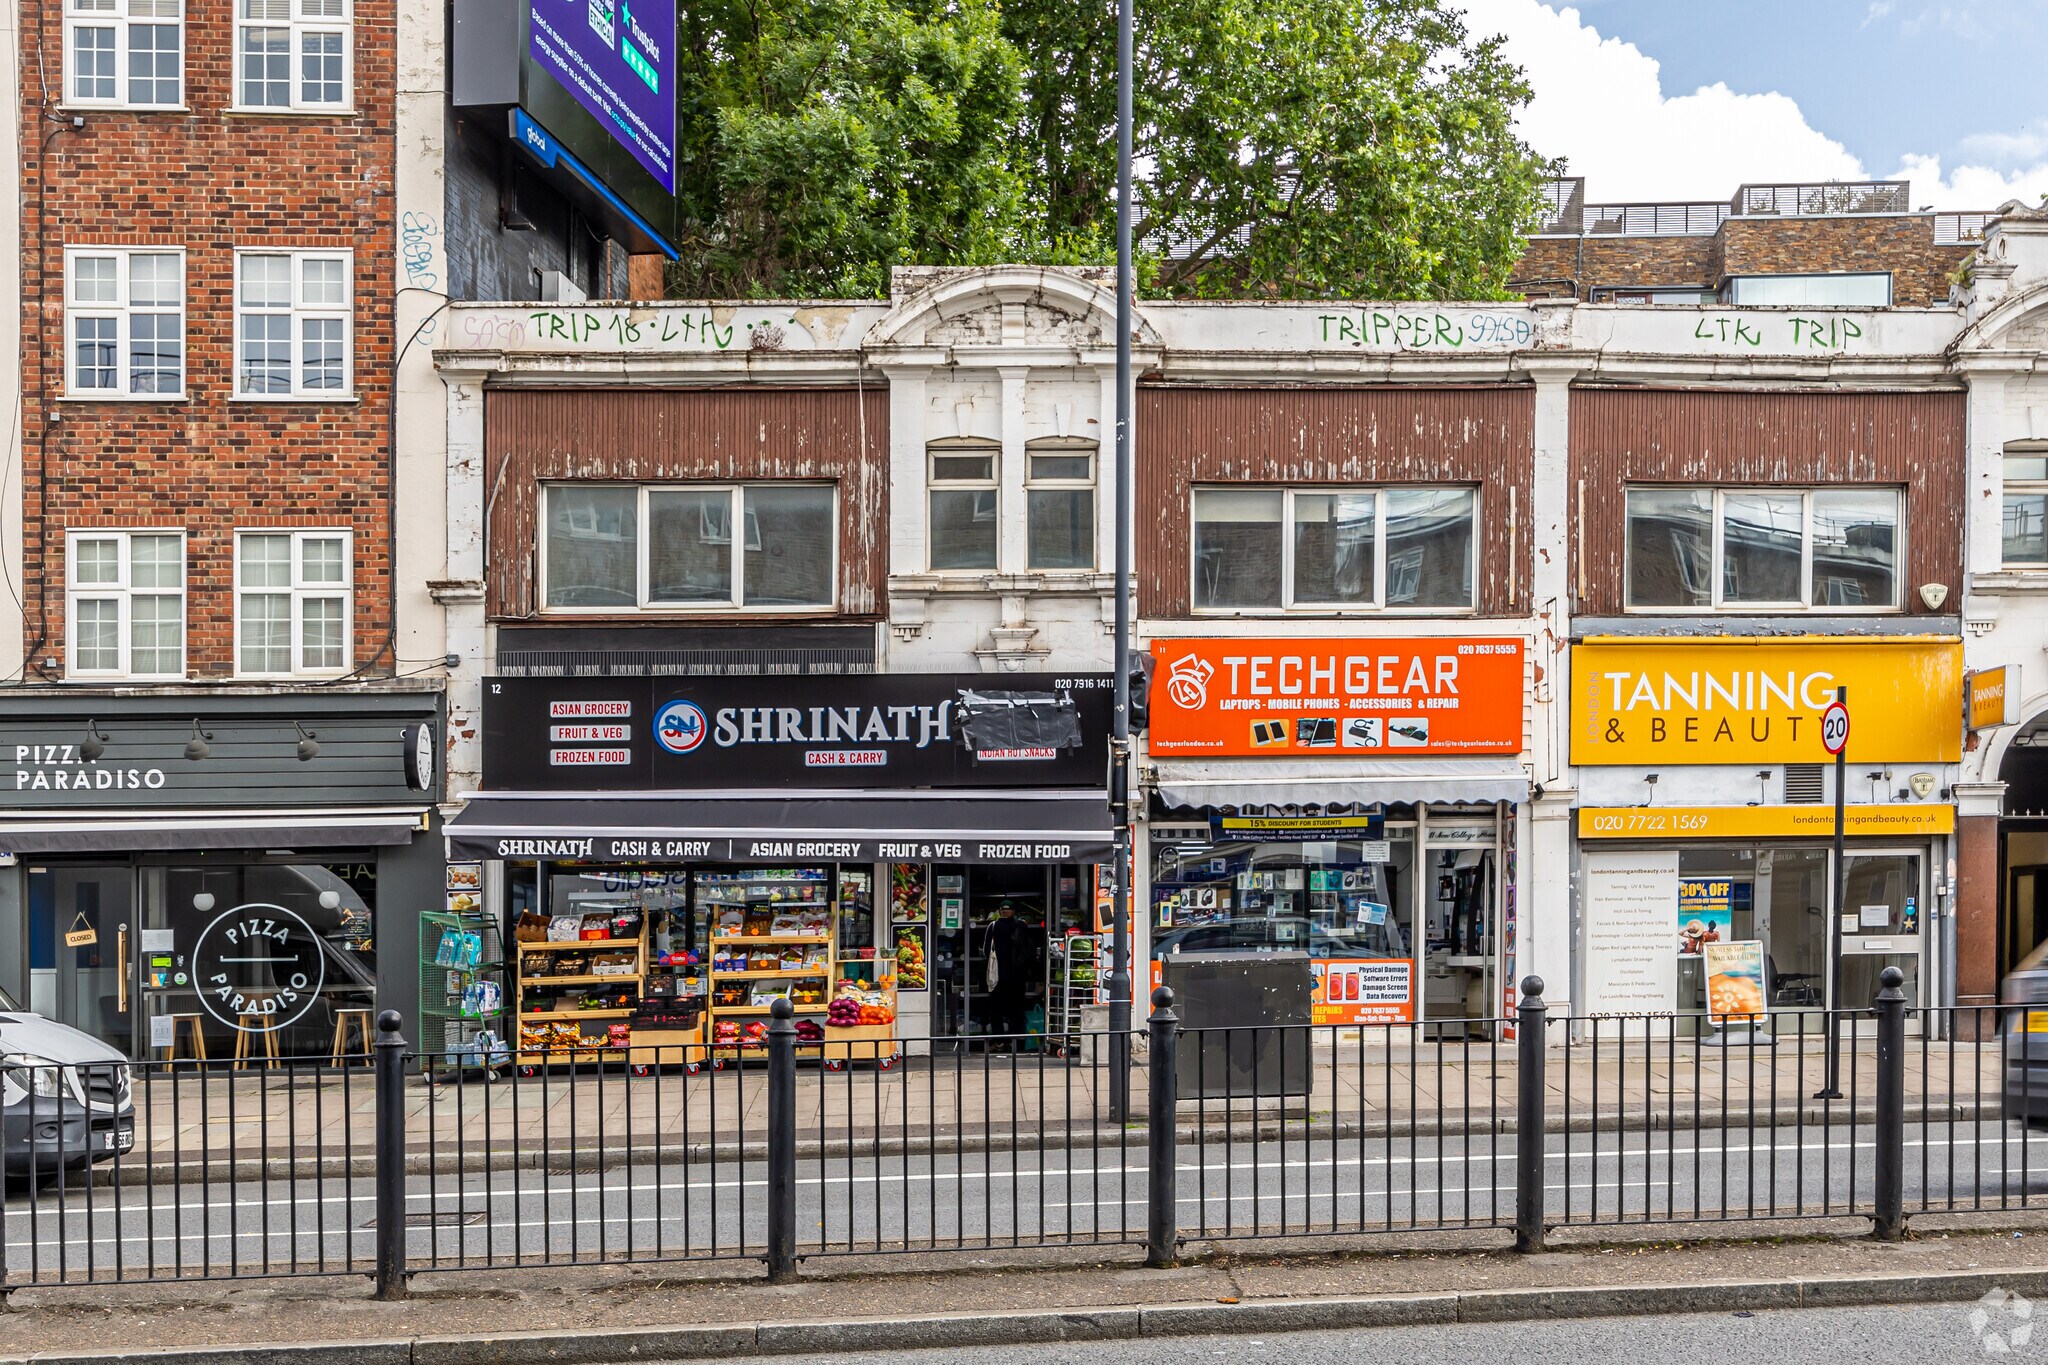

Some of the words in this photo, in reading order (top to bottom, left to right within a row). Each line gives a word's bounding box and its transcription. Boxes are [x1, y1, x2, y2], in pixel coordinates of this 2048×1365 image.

[532, 7, 546, 30] Based
[552, 30, 564, 49] more
[564, 41, 574, 59] than
[590, 9, 614, 45] ETHICAL
[630, 15, 660, 63] Trustpilot
[535, 34, 551, 57] energy
[551, 49, 568, 72] supplier
[527, 125, 546, 151] global
[530, 312, 601, 343] TRIP
[1318, 311, 1464, 348] TRIPPER
[1788, 317, 1862, 350] TRIP
[1457, 645, 1474, 655] 020
[1475, 645, 1494, 654] 7637
[1495, 644, 1517, 654] 5555
[1054, 679, 1072, 689] 020
[1074, 679, 1094, 689] 7916
[1222, 655, 1459, 696] TECHGEAR
[491, 683, 502, 694] 12
[1604, 670, 1838, 711] TANNING
[1973, 683, 2004, 703] TANNING
[552, 703, 582, 715] ASIAN
[584, 703, 629, 715] GROCERY
[1220, 699, 1261, 710] LAPTOPS
[1268, 699, 1302, 710] MOBILE
[1304, 698, 1340, 709] PHONES
[1349, 698, 1412, 709] ACCESSORIES
[1418, 698, 1425, 708] &
[1427, 698, 1459, 709] REPAIR
[1587, 671, 1599, 744] LONDON
[1979, 699, 2004, 711] BEAUTY
[558, 727, 588, 739] FRUIT
[591, 727, 599, 739] &
[603, 727, 623, 739] VEG
[714, 699, 952, 748] SHRINATH
[1605, 717, 1625, 743] &
[1651, 716, 1826, 742] BEAUT
[1826, 715, 1847, 740] 20
[1156, 740, 1224, 748] techgearlondon.co.uk
[1430, 739, 1513, 748] sales@techgearlondon.co.uk
[16, 745, 97, 765] PIZZ
[556, 751, 595, 763] FROZEN
[598, 751, 625, 763] FOOD
[808, 753, 835, 764] CASH
[838, 753, 846, 764] &
[849, 752, 883, 764] CARRY
[16, 768, 166, 790] PARADISO
[1250, 819, 1266, 827] 15%
[1594, 815, 1624, 831] 020
[1628, 815, 1666, 830] 7722
[1672, 814, 1708, 830] 1569
[498, 838, 594, 859] SHRINATH
[611, 840, 649, 856] CASH
[651, 841, 662, 856] &
[665, 841, 711, 857] CARRY
[750, 843, 793, 857] ASIAN
[796, 842, 861, 857] GROCERY
[878, 843, 918, 858] FRUIT
[920, 845, 932, 858] &
[935, 843, 962, 858] VEG
[979, 844, 1031, 859] FROZEN
[1034, 844, 1071, 859] FOOD
[1681, 883, 1707, 897] 50%
[1709, 883, 1729, 897] OFF
[70, 933, 92, 943] CLOSED
[225, 918, 290, 945] PIZZA
[1359, 966, 1384, 974] Physical
[1384, 966, 1408, 974] Damage
[210, 972, 308, 1016] PARADISO
[1380, 992, 1408, 1001] Recovery
[1314, 1005, 1343, 1015] REPAIRS
[1360, 1006, 1372, 1014] 020
